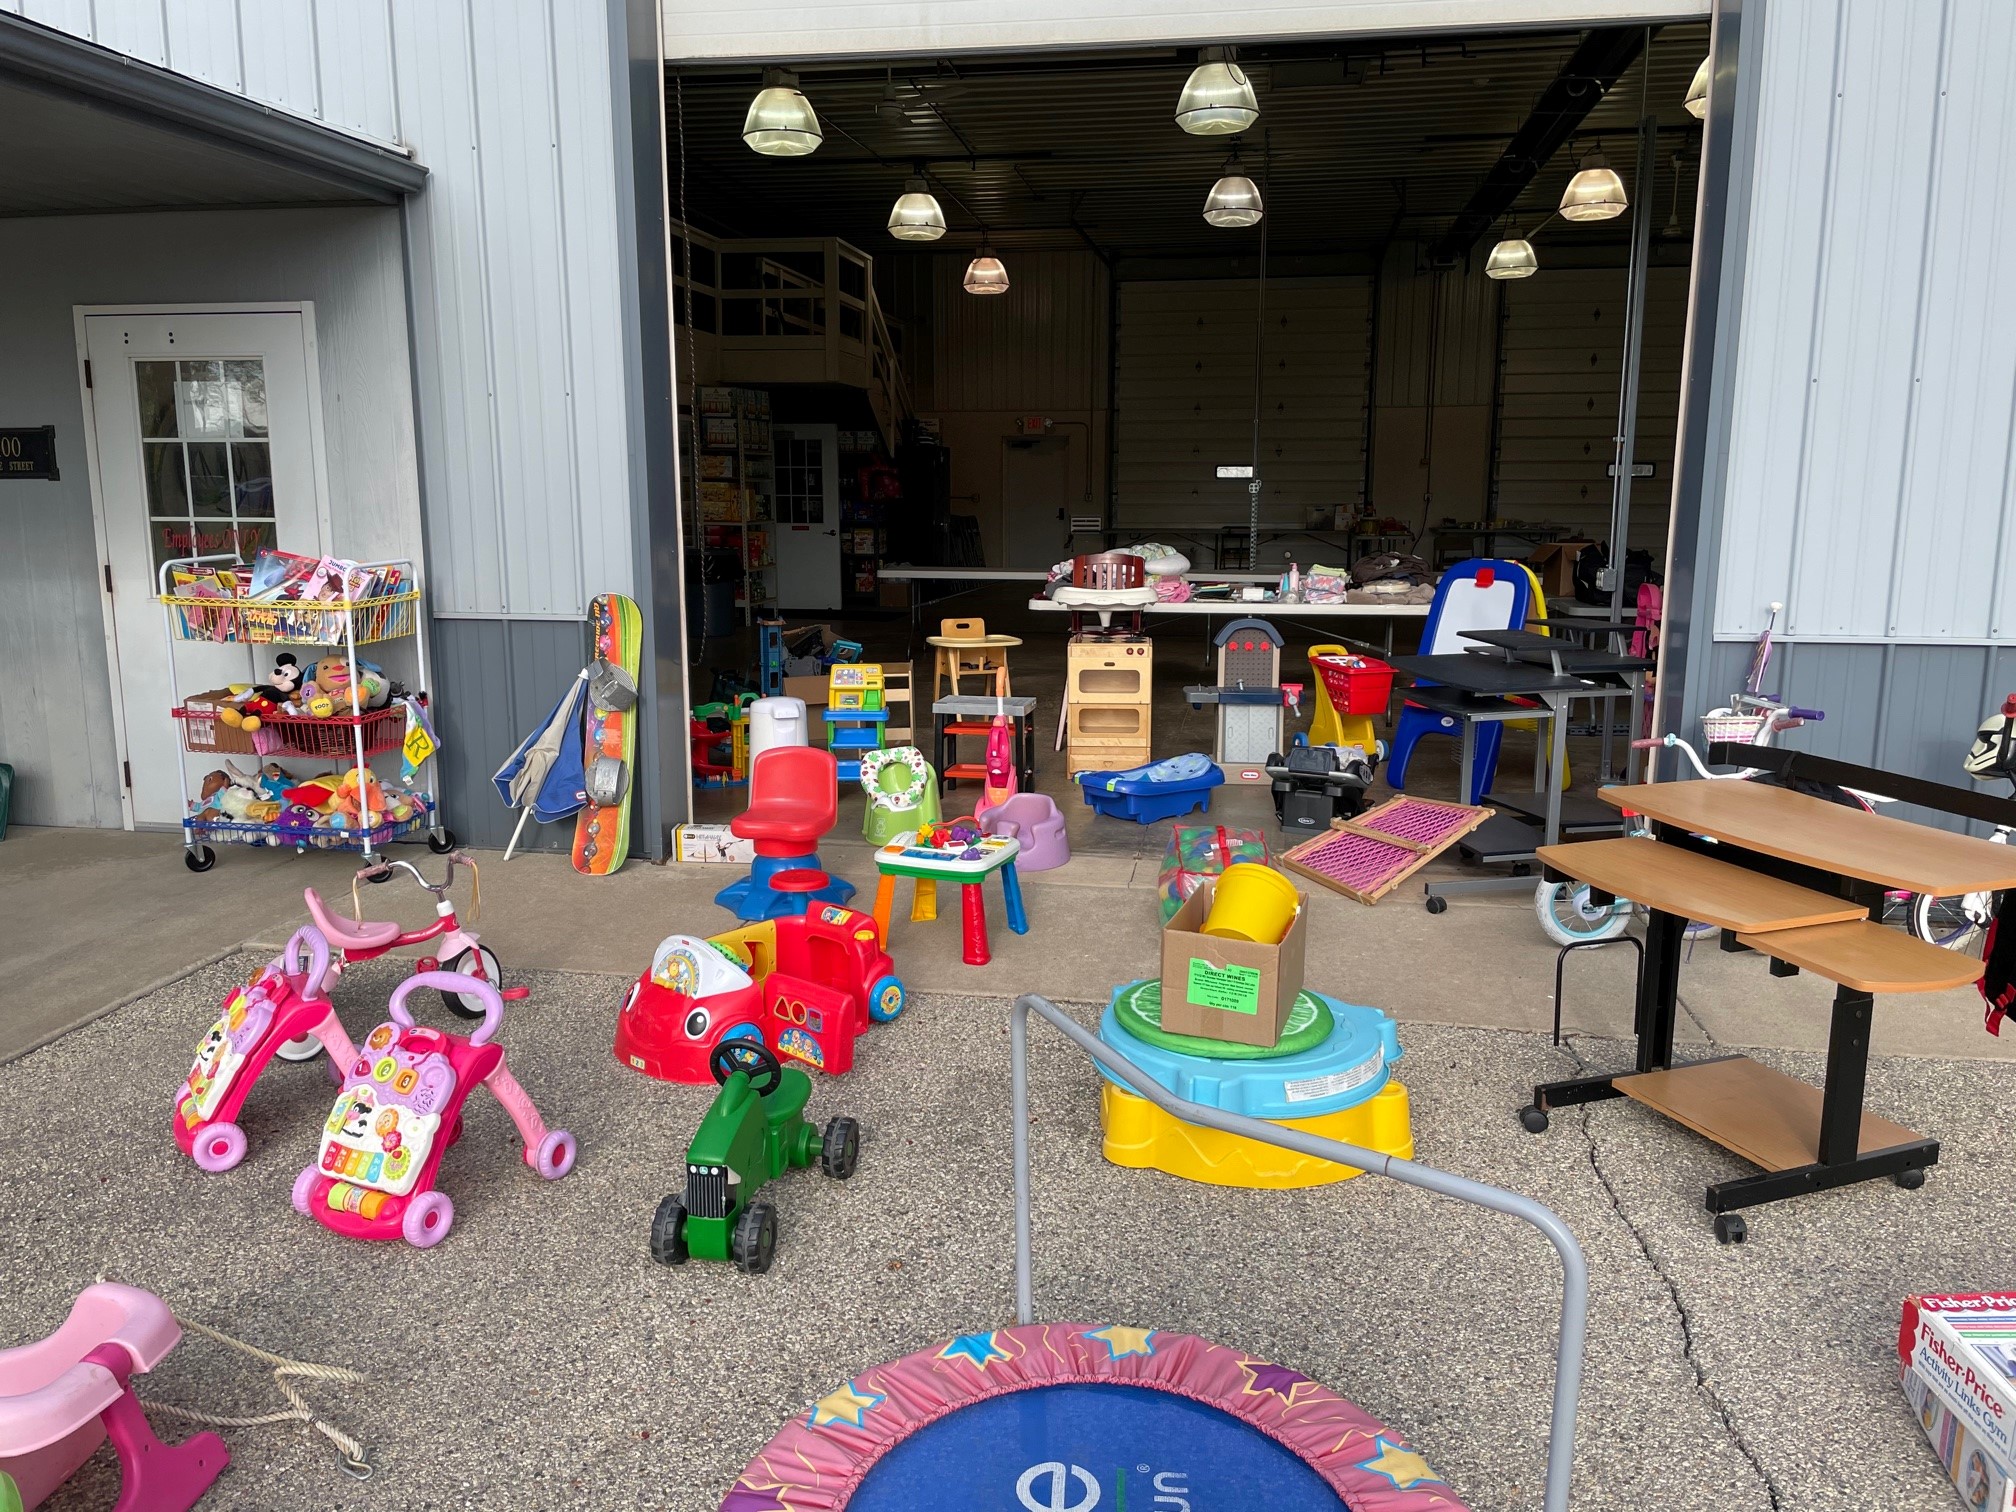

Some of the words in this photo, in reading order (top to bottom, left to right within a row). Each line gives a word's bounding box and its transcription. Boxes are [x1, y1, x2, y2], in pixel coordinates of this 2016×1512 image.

[0, 436, 21, 458] 00
[9, 461, 34, 471] STREET
[162, 527, 221, 557] Employees
[405, 732, 430, 759] R
[1920, 1321, 2004, 1420] Fisher-Price
[1920, 1346, 1954, 1389] Activity
[1955, 1381, 1981, 1417] Links
[1983, 1411, 2007, 1445] Gym
